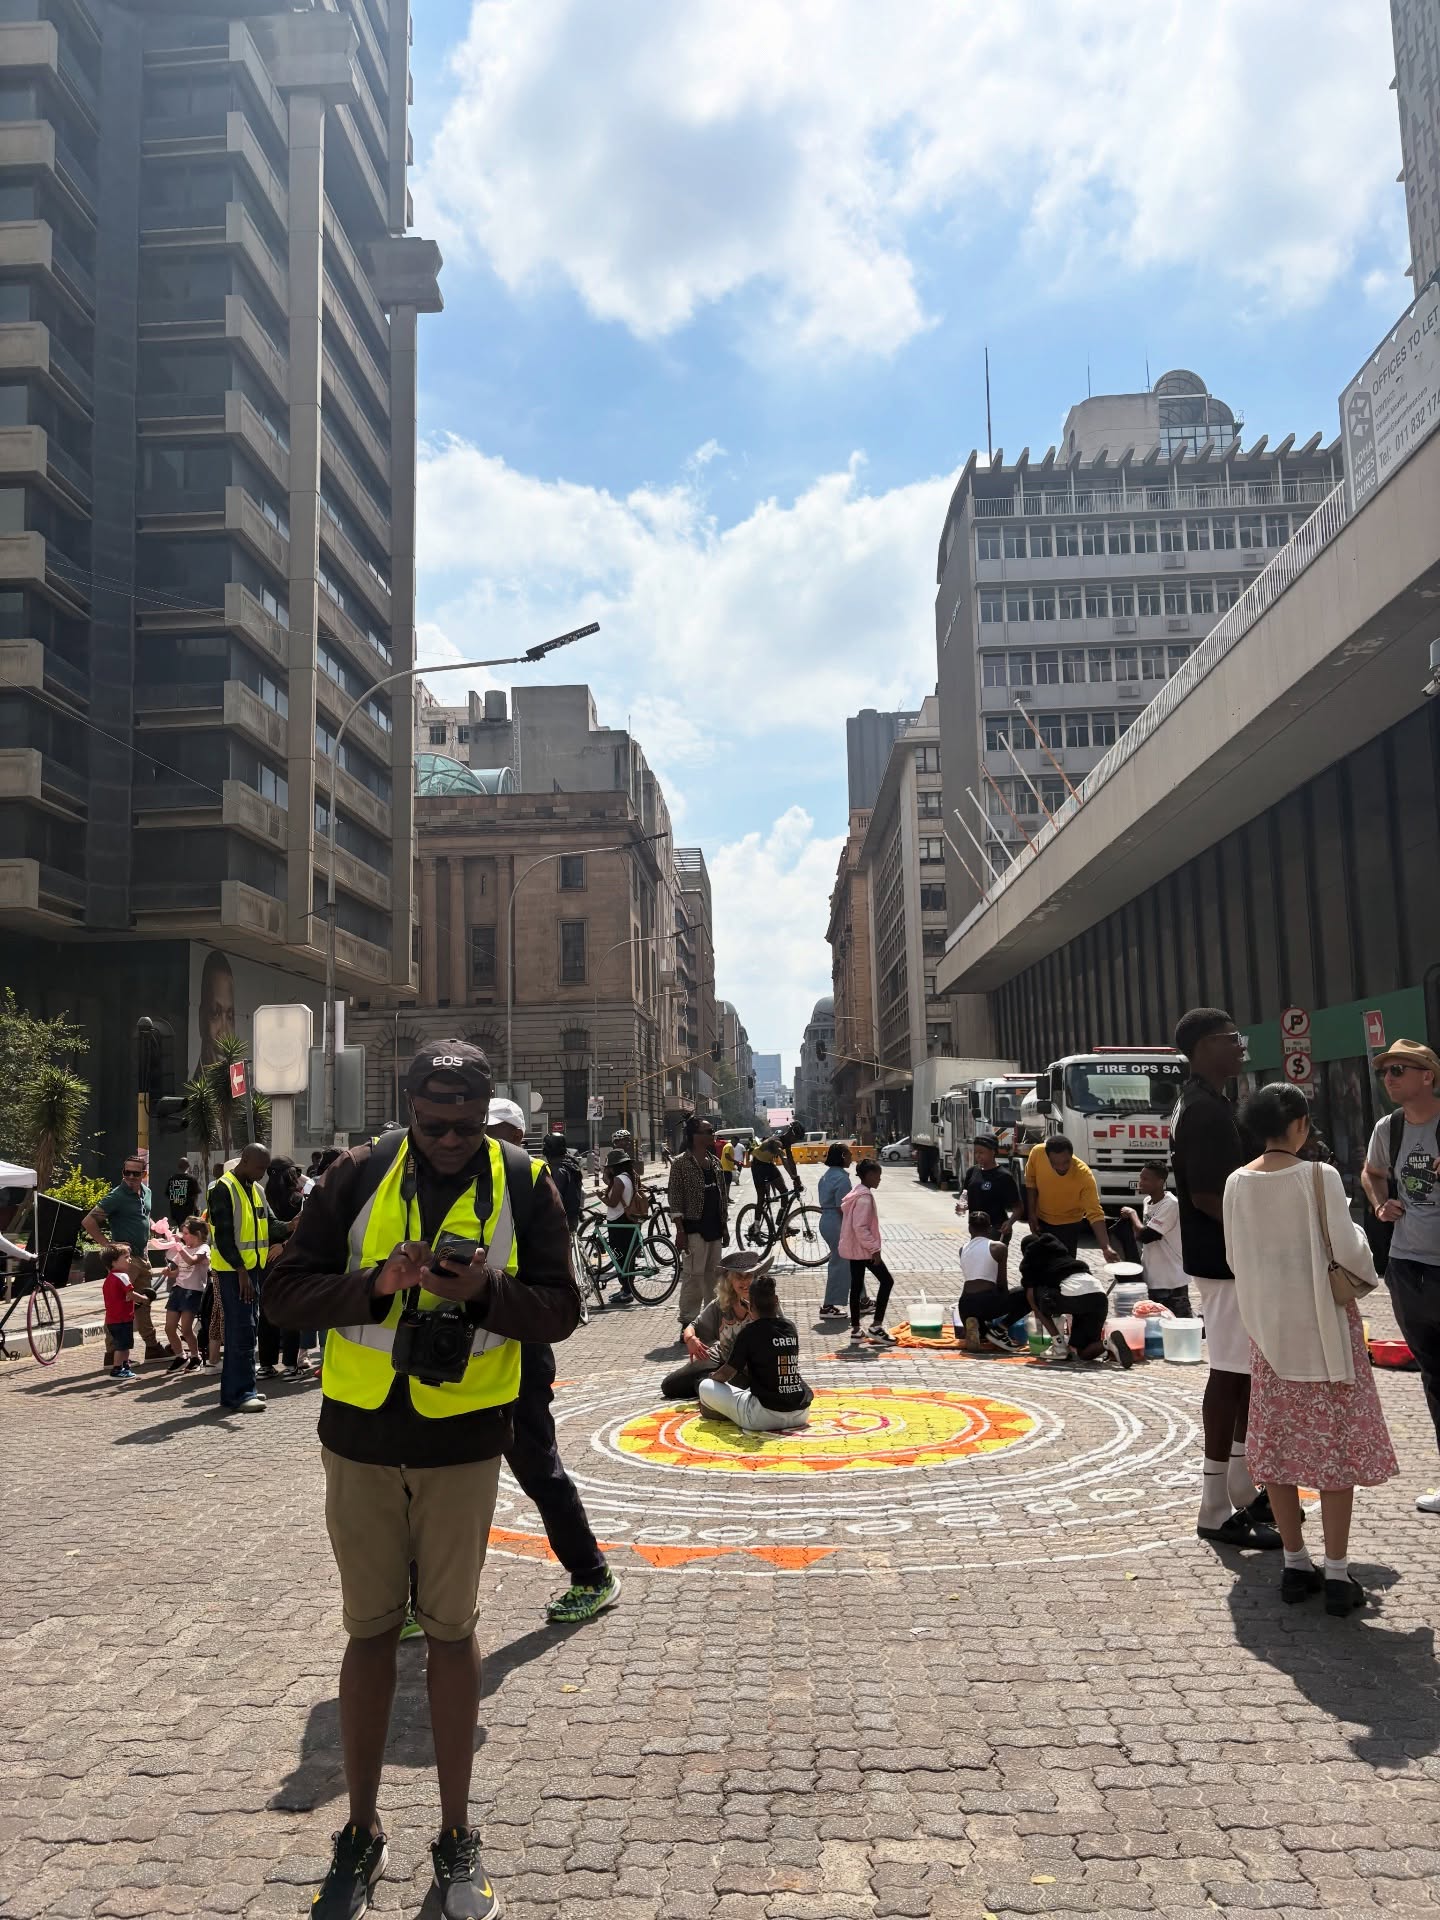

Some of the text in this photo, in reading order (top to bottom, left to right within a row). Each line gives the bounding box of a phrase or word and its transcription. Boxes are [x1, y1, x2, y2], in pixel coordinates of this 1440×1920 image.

[1372, 345, 1407, 396] OFFICES
[1408, 329, 1421, 353] TO
[1422, 305, 1439, 336] LET
[1379, 446, 1392, 469] Tel:
[1395, 425, 1409, 452] 011
[1411, 406, 1426, 434] 832
[1354, 440, 1374, 470] JOHA
[1355, 455, 1375, 485] NNES
[1356, 472, 1376, 501] BURG
[432, 1055, 463, 1067] EOS
[1096, 1065, 1181, 1074] FIRE OPS SA
[1128, 1140, 1163, 1148] ISUZU
[1408, 1155, 1430, 1163] KILLER
[772, 1337, 798, 1347] CREW
